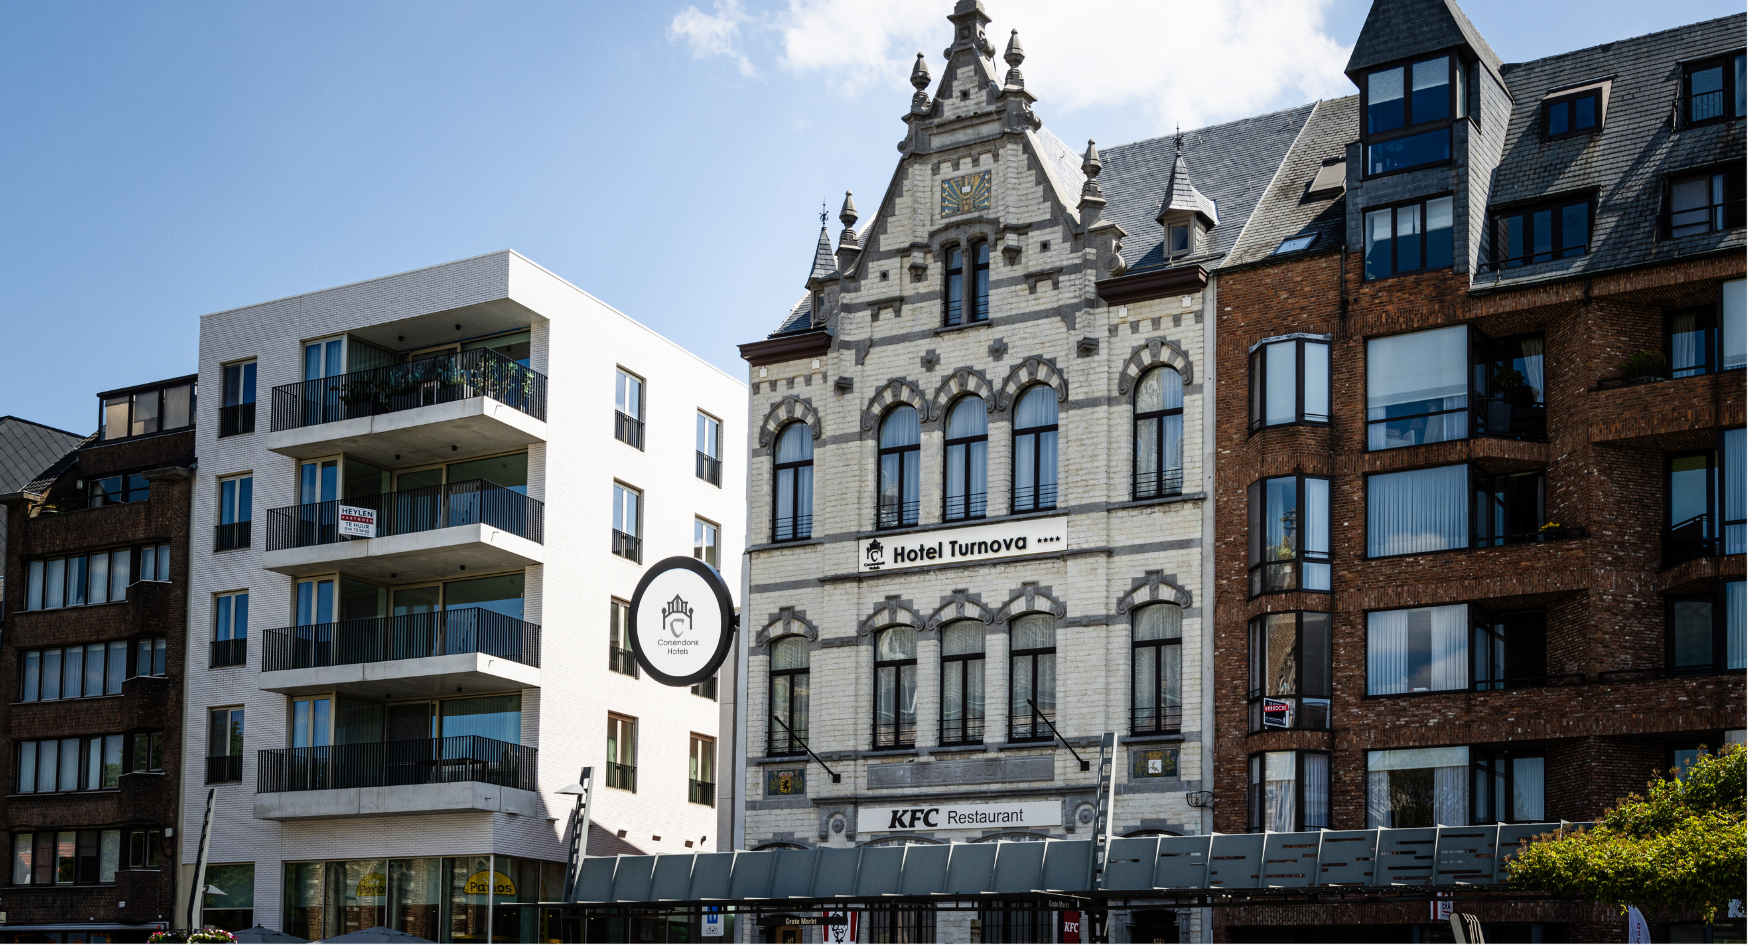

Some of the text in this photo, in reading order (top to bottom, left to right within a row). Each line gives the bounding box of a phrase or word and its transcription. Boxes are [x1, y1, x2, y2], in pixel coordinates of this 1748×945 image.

[342, 508, 373, 517] HEYLEN
[893, 536, 1027, 563] Hotel Turnova
[888, 808, 1023, 828] KFC Restaurant
[361, 885, 386, 893] Pano
[801, 917, 817, 925] Markt
[1064, 921, 1079, 933] KFC
